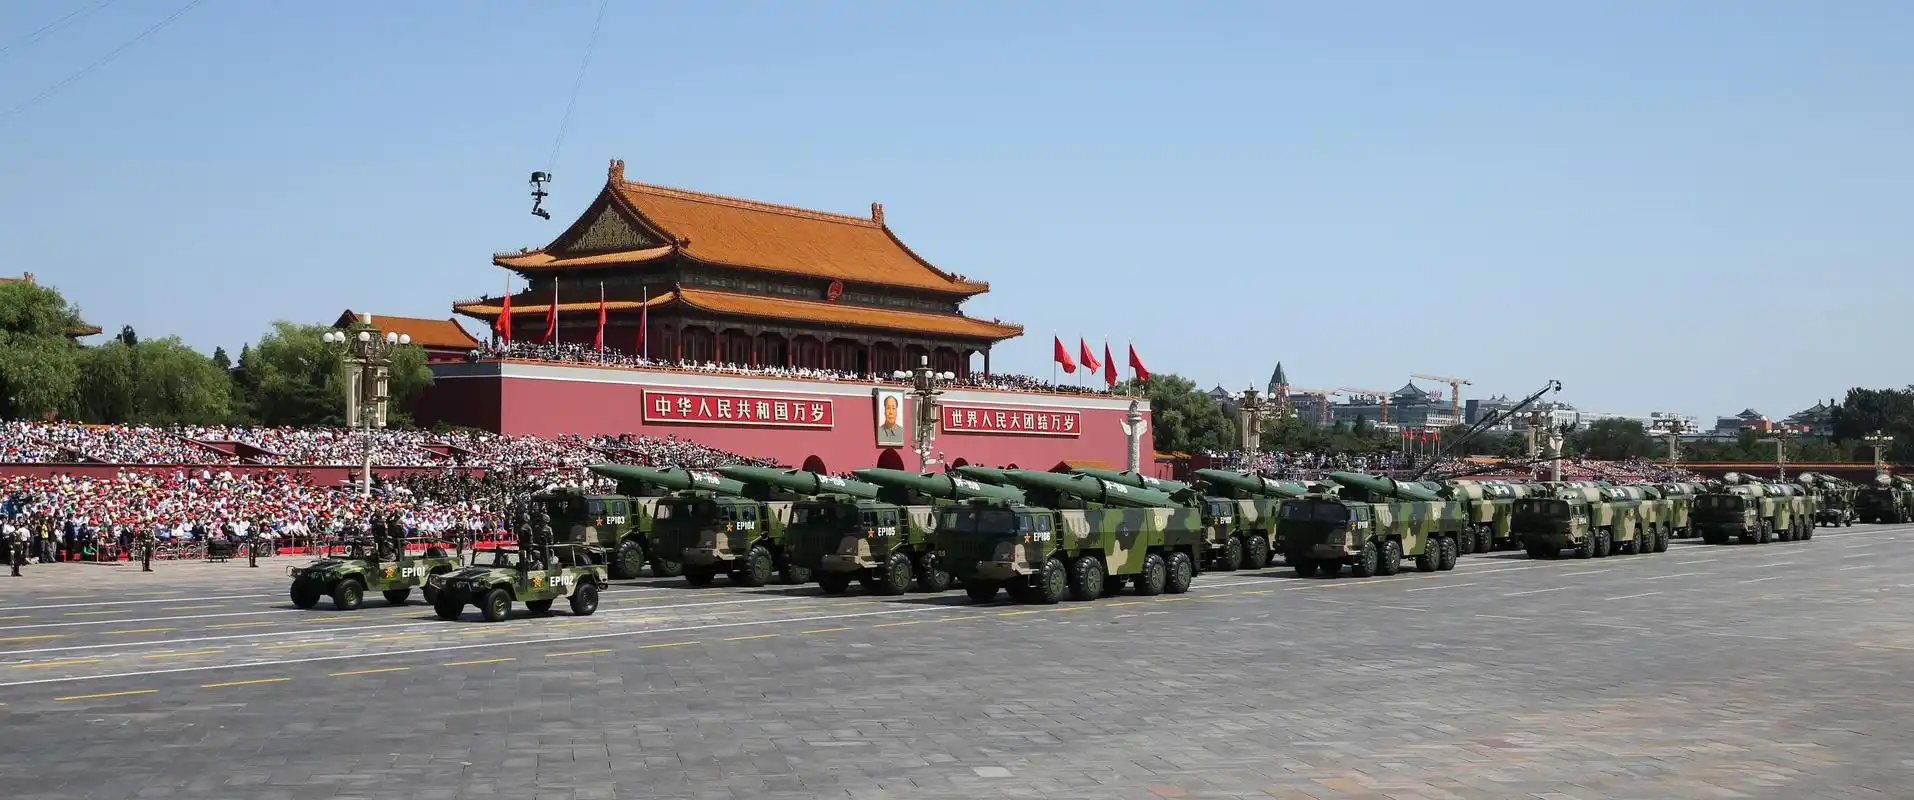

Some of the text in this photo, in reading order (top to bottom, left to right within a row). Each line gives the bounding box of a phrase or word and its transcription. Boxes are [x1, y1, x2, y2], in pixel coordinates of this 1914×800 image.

[655, 396, 824, 422] 中华人民共和国万岁
[951, 409, 1074, 431] 世界人民大团结万岁
[606, 516, 625, 525] EP103
[736, 521, 755, 531] EP104
[877, 527, 896, 537] EP105
[1033, 531, 1051, 542] EP106
[402, 566, 426, 578] EP101
[550, 575, 574, 587] EP102
